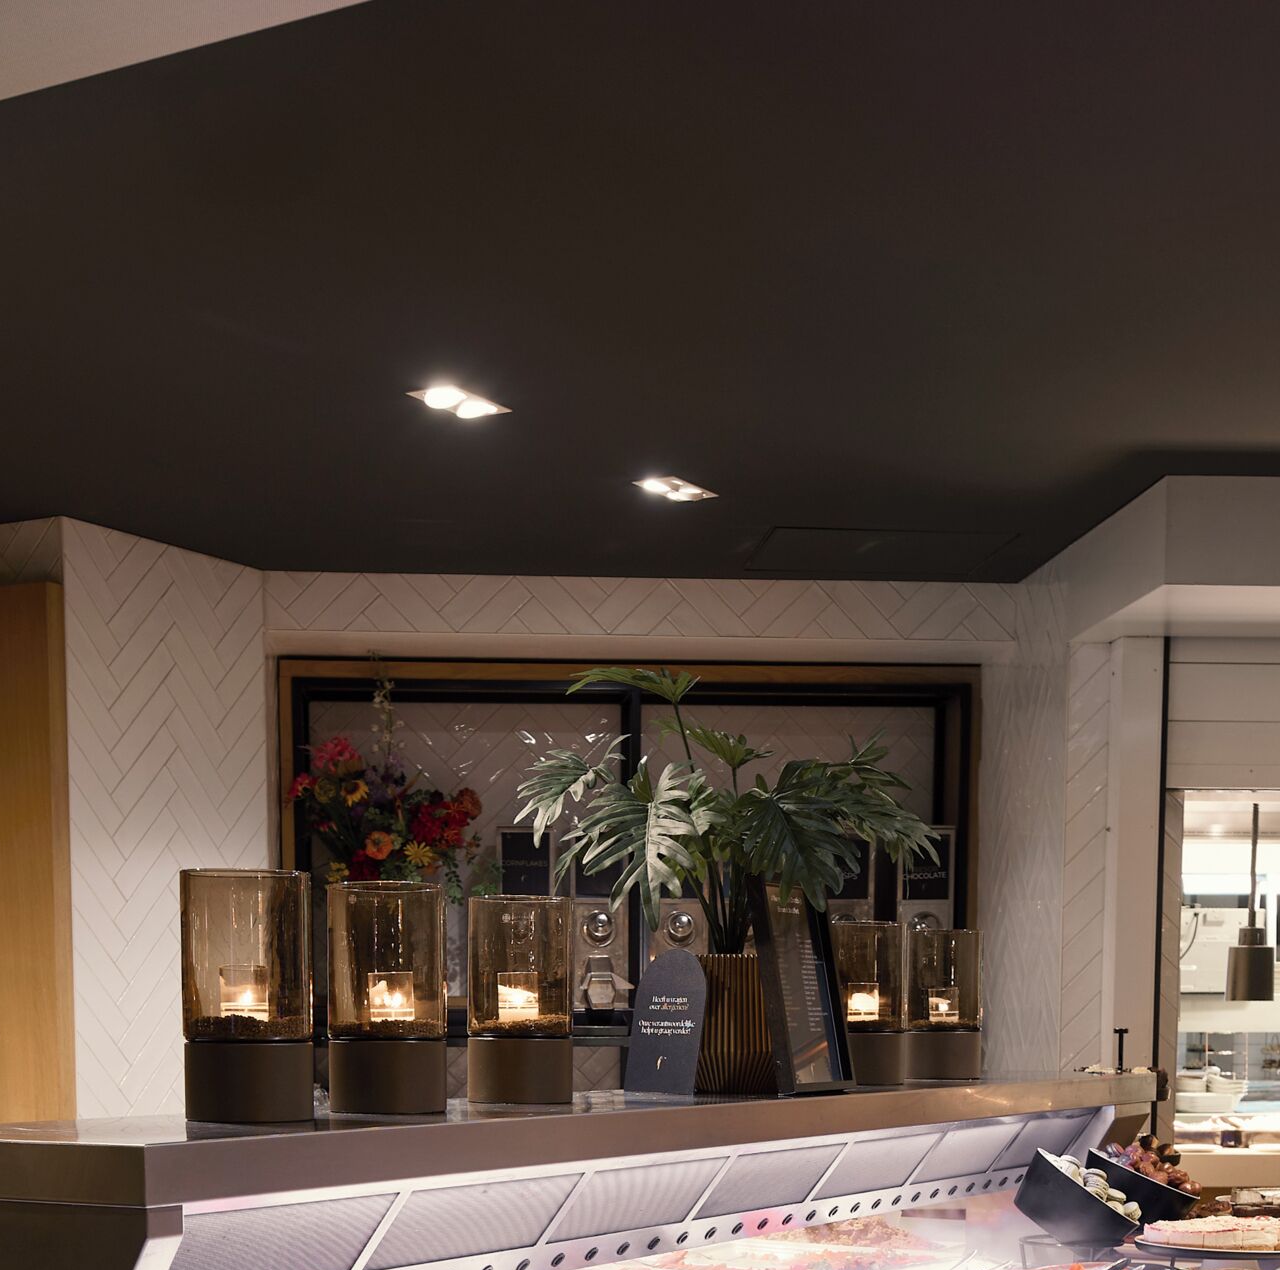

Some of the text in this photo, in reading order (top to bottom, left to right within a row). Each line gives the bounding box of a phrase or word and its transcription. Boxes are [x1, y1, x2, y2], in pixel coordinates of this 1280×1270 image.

[903, 871, 947, 880] CHOCOLATE
[652, 995, 666, 1003] Heeft
[641, 1026, 654, 1036] helpt
